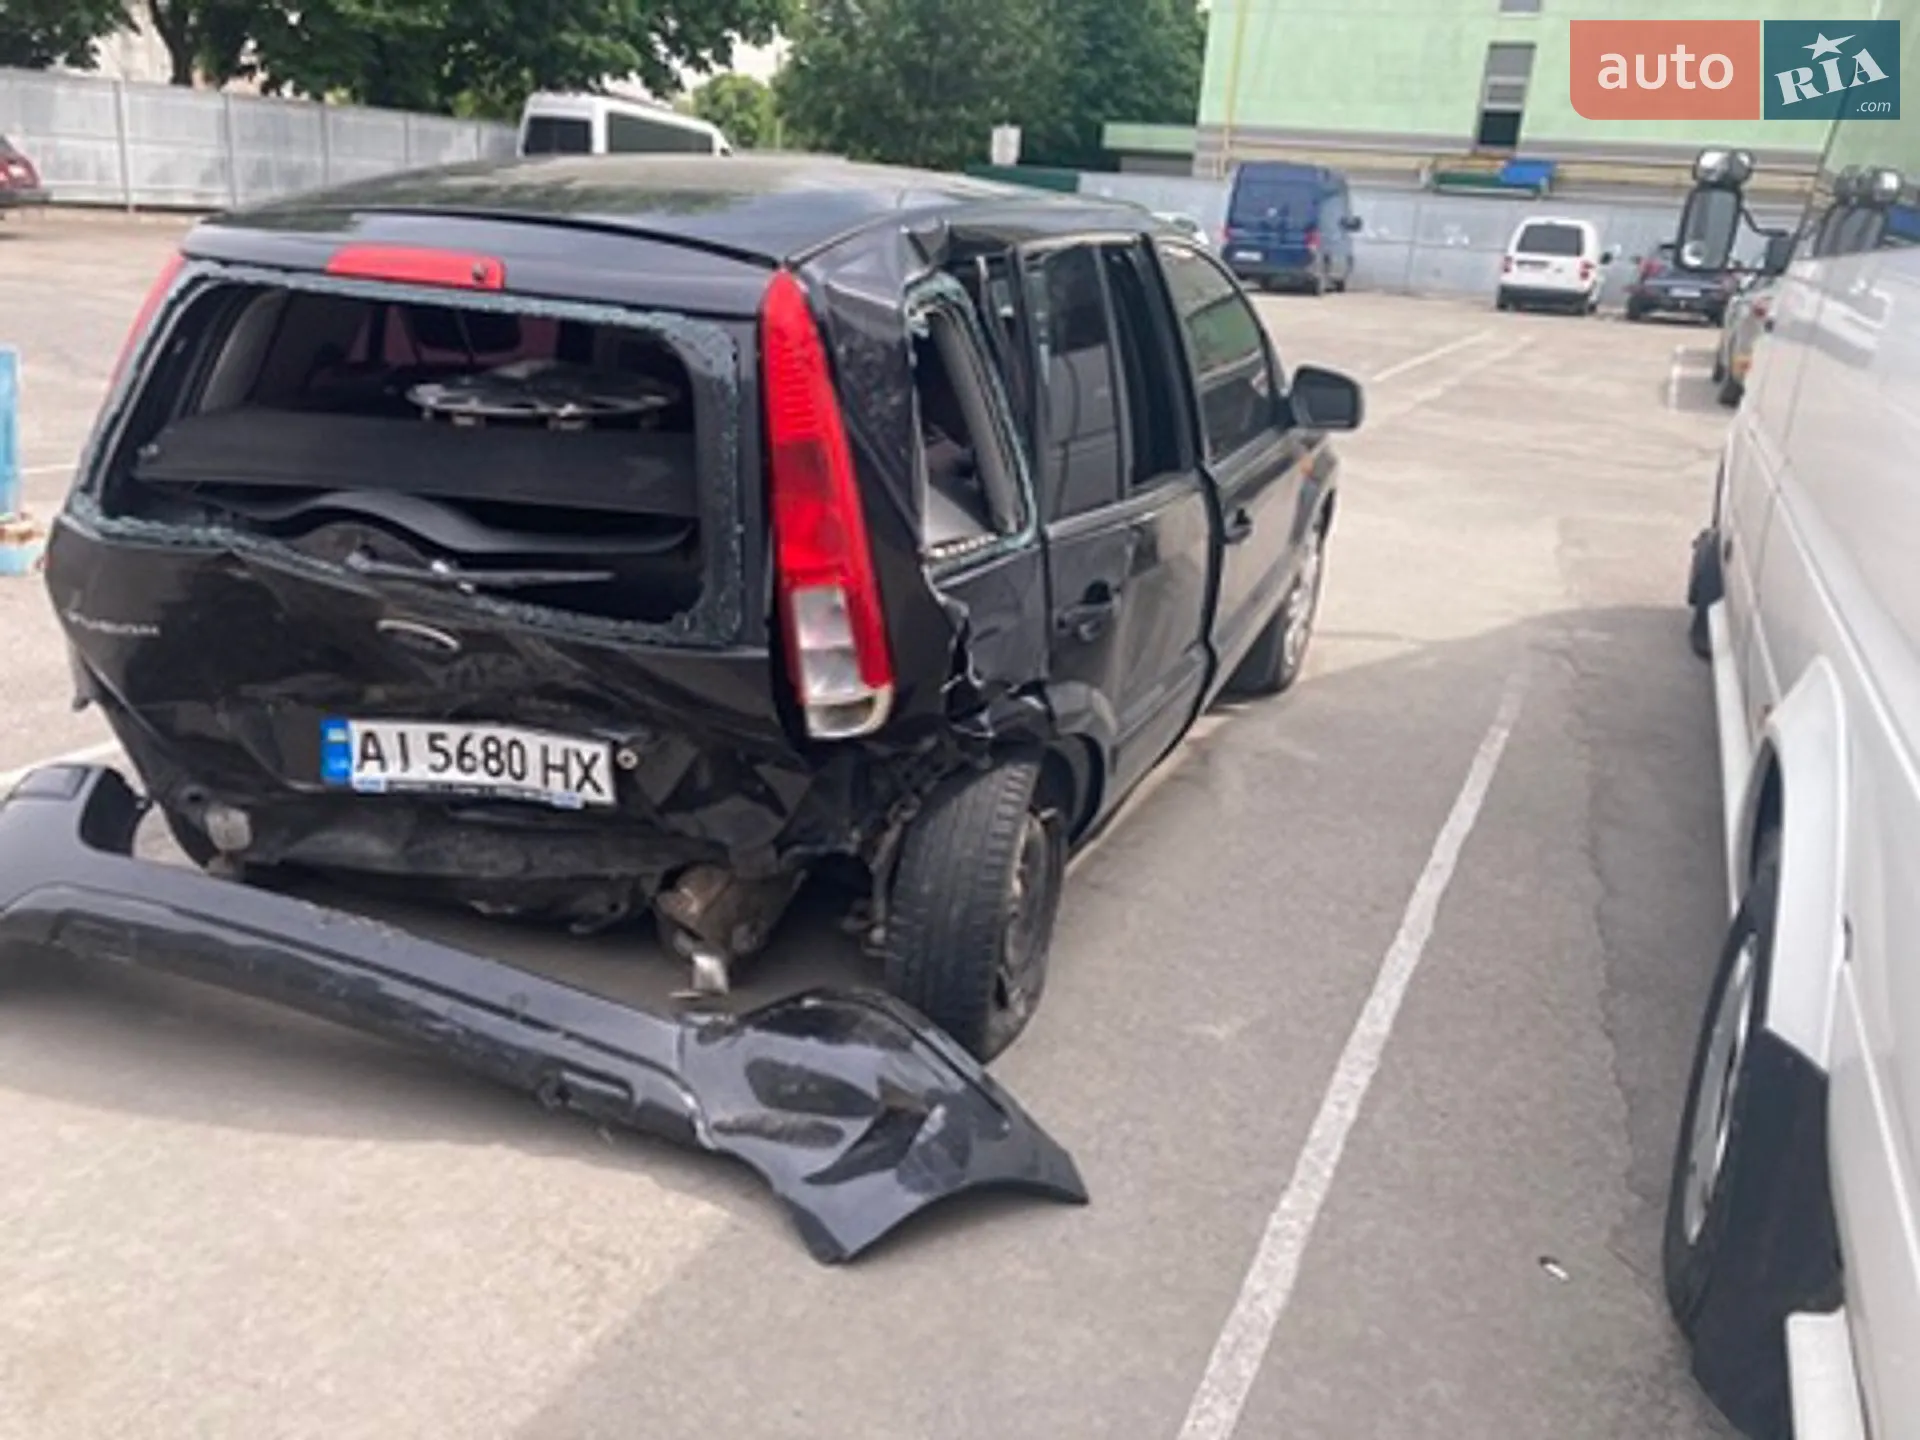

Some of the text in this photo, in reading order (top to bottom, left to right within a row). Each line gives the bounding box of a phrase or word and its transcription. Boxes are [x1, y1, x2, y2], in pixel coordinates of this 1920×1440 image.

[357, 731, 604, 796] AI 5680 HX
